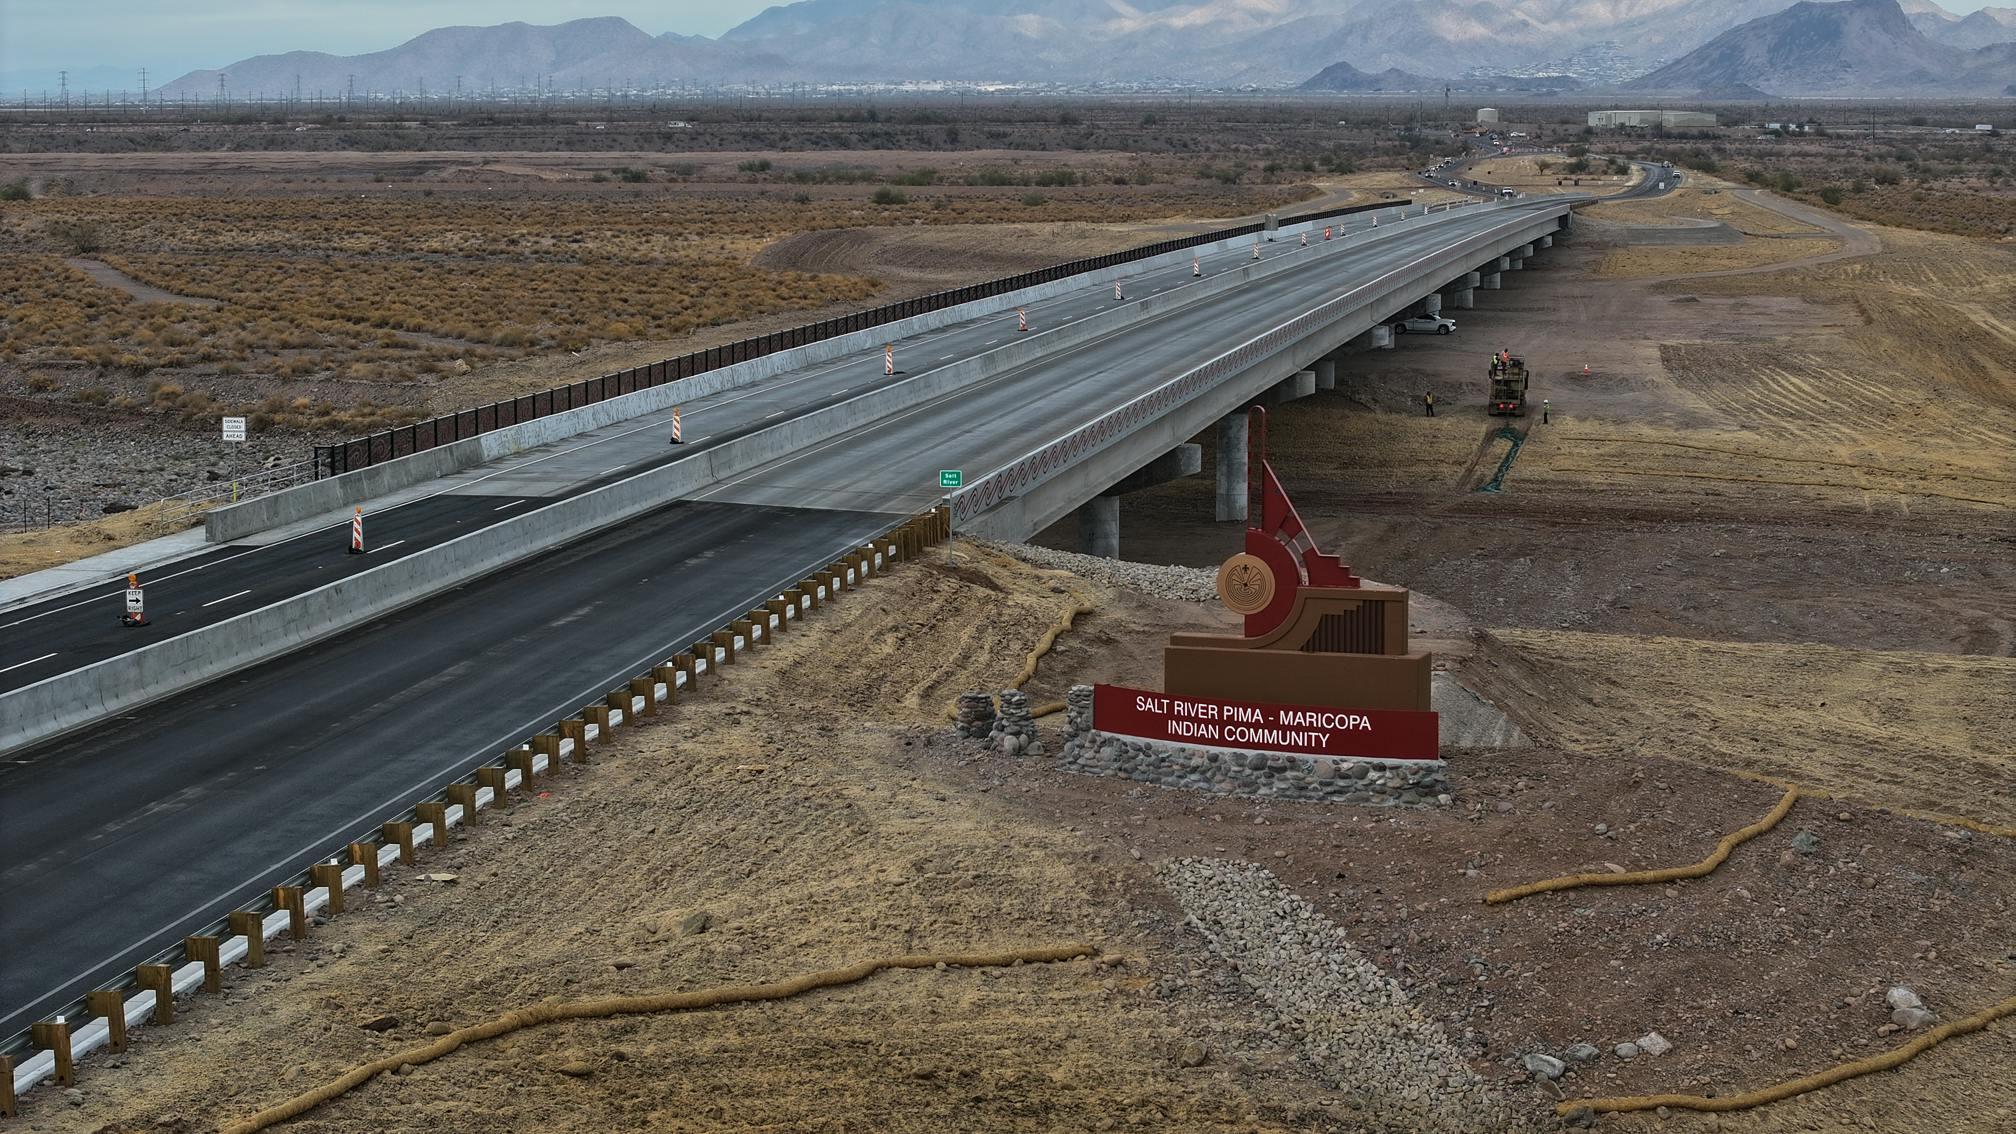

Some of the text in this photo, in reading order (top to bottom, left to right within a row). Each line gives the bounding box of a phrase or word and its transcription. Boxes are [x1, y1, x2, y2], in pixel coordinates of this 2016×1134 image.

[1136, 696, 1170, 714] SALT
[1174, 700, 1218, 720] RIVER
[1223, 706, 1264, 724] PIMA
[1280, 710, 1372, 731] MARICOPA
[1168, 719, 1330, 748] INDIAN COMMUNITY
